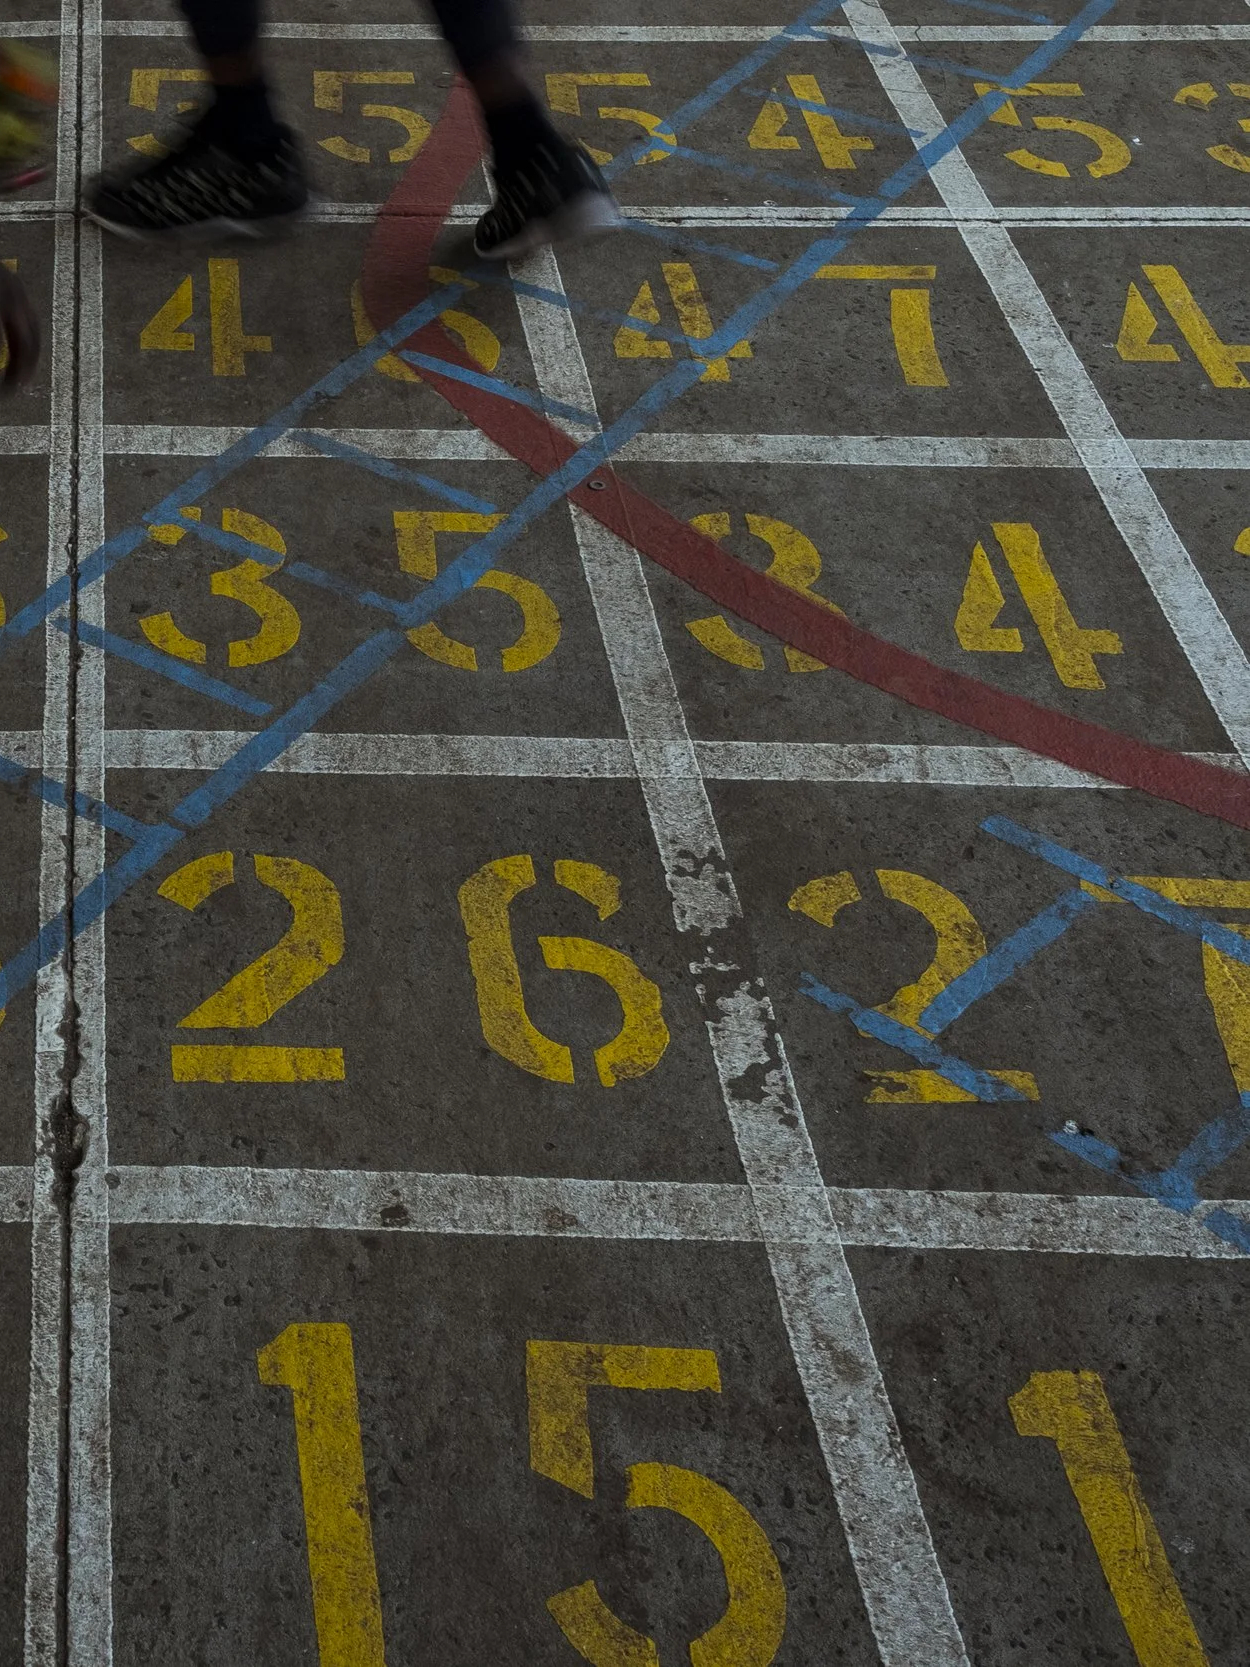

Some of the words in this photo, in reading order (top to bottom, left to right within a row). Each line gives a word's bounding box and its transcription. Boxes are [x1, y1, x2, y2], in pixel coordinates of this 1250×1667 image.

[545, 72, 875, 170] 54
[138, 256, 502, 383] 46
[612, 262, 950, 388] 47
[138, 505, 563, 673] 35
[684, 511, 1124, 690] 34
[156, 849, 671, 1088] 26
[787, 867, 1250, 1105] 27
[255, 1320, 788, 1667] 15
